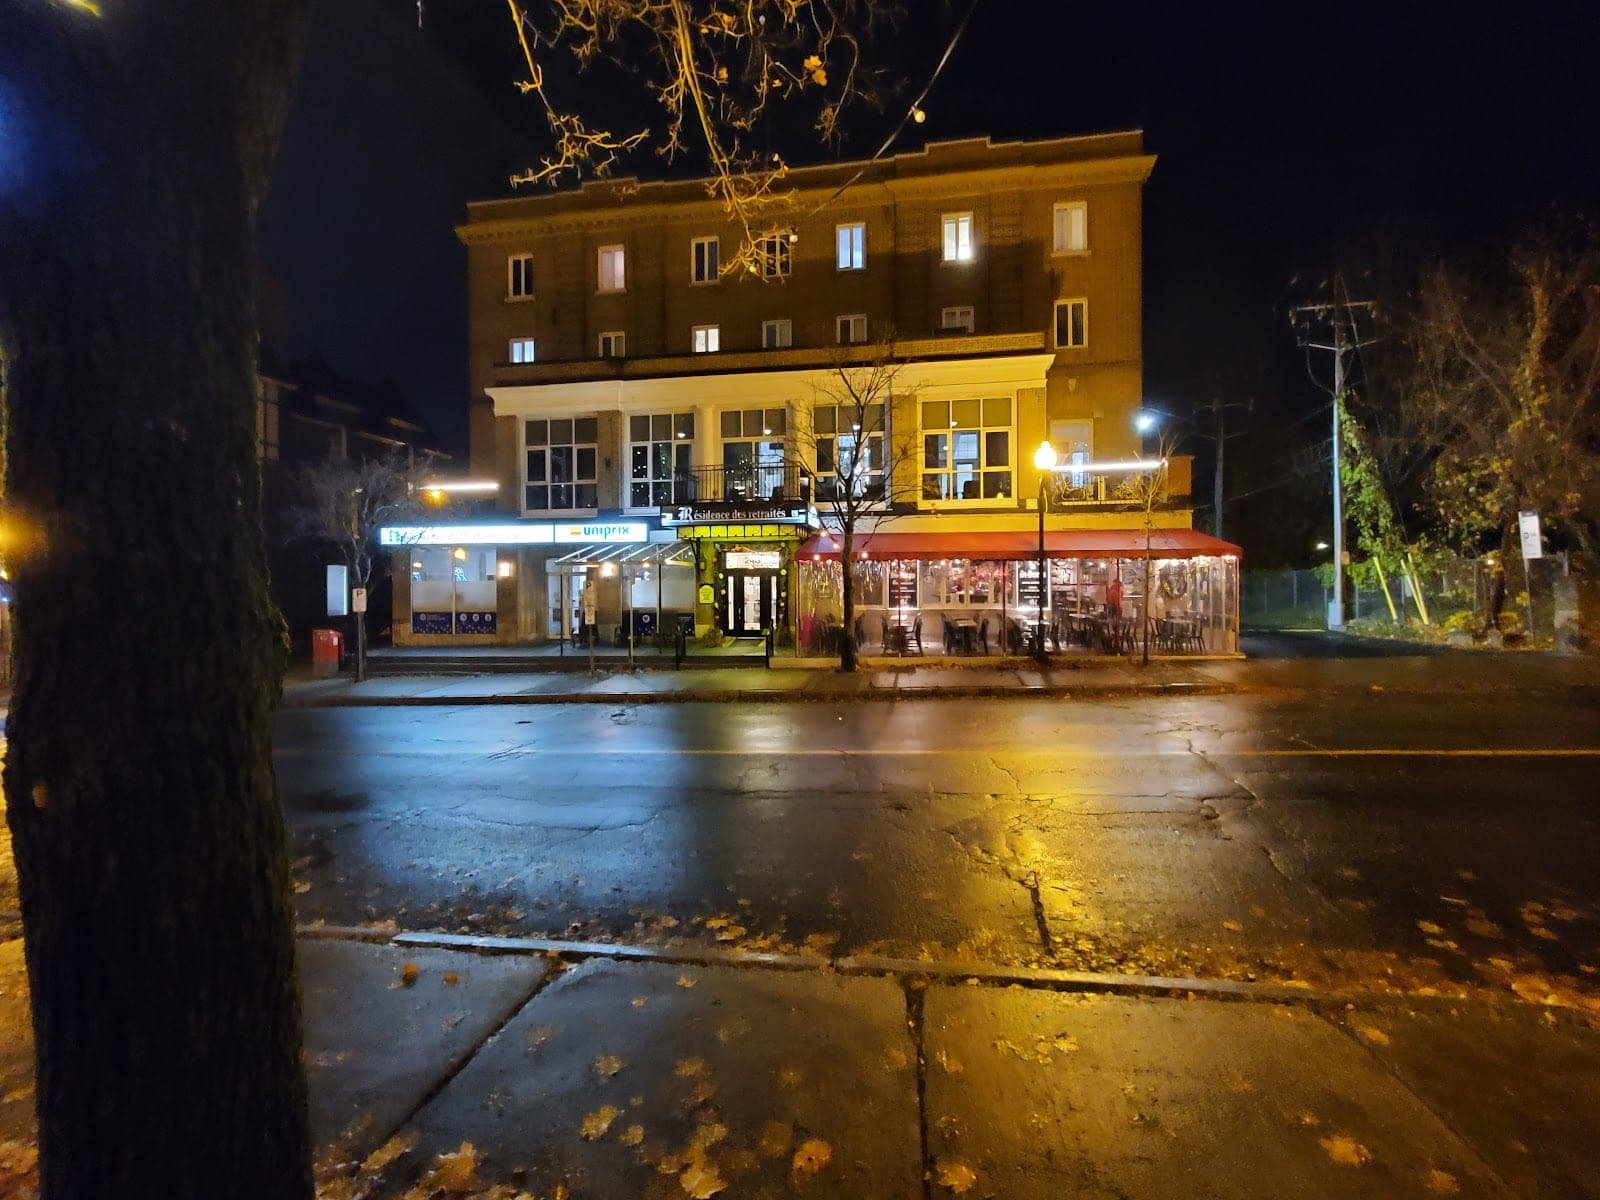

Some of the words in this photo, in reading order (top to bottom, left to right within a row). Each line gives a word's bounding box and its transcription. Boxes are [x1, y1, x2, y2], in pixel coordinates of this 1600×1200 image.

[677, 506, 729, 522] Résidence
[731, 509, 746, 520] des
[748, 508, 786, 519] retraités
[583, 525, 630, 540] uniprix
